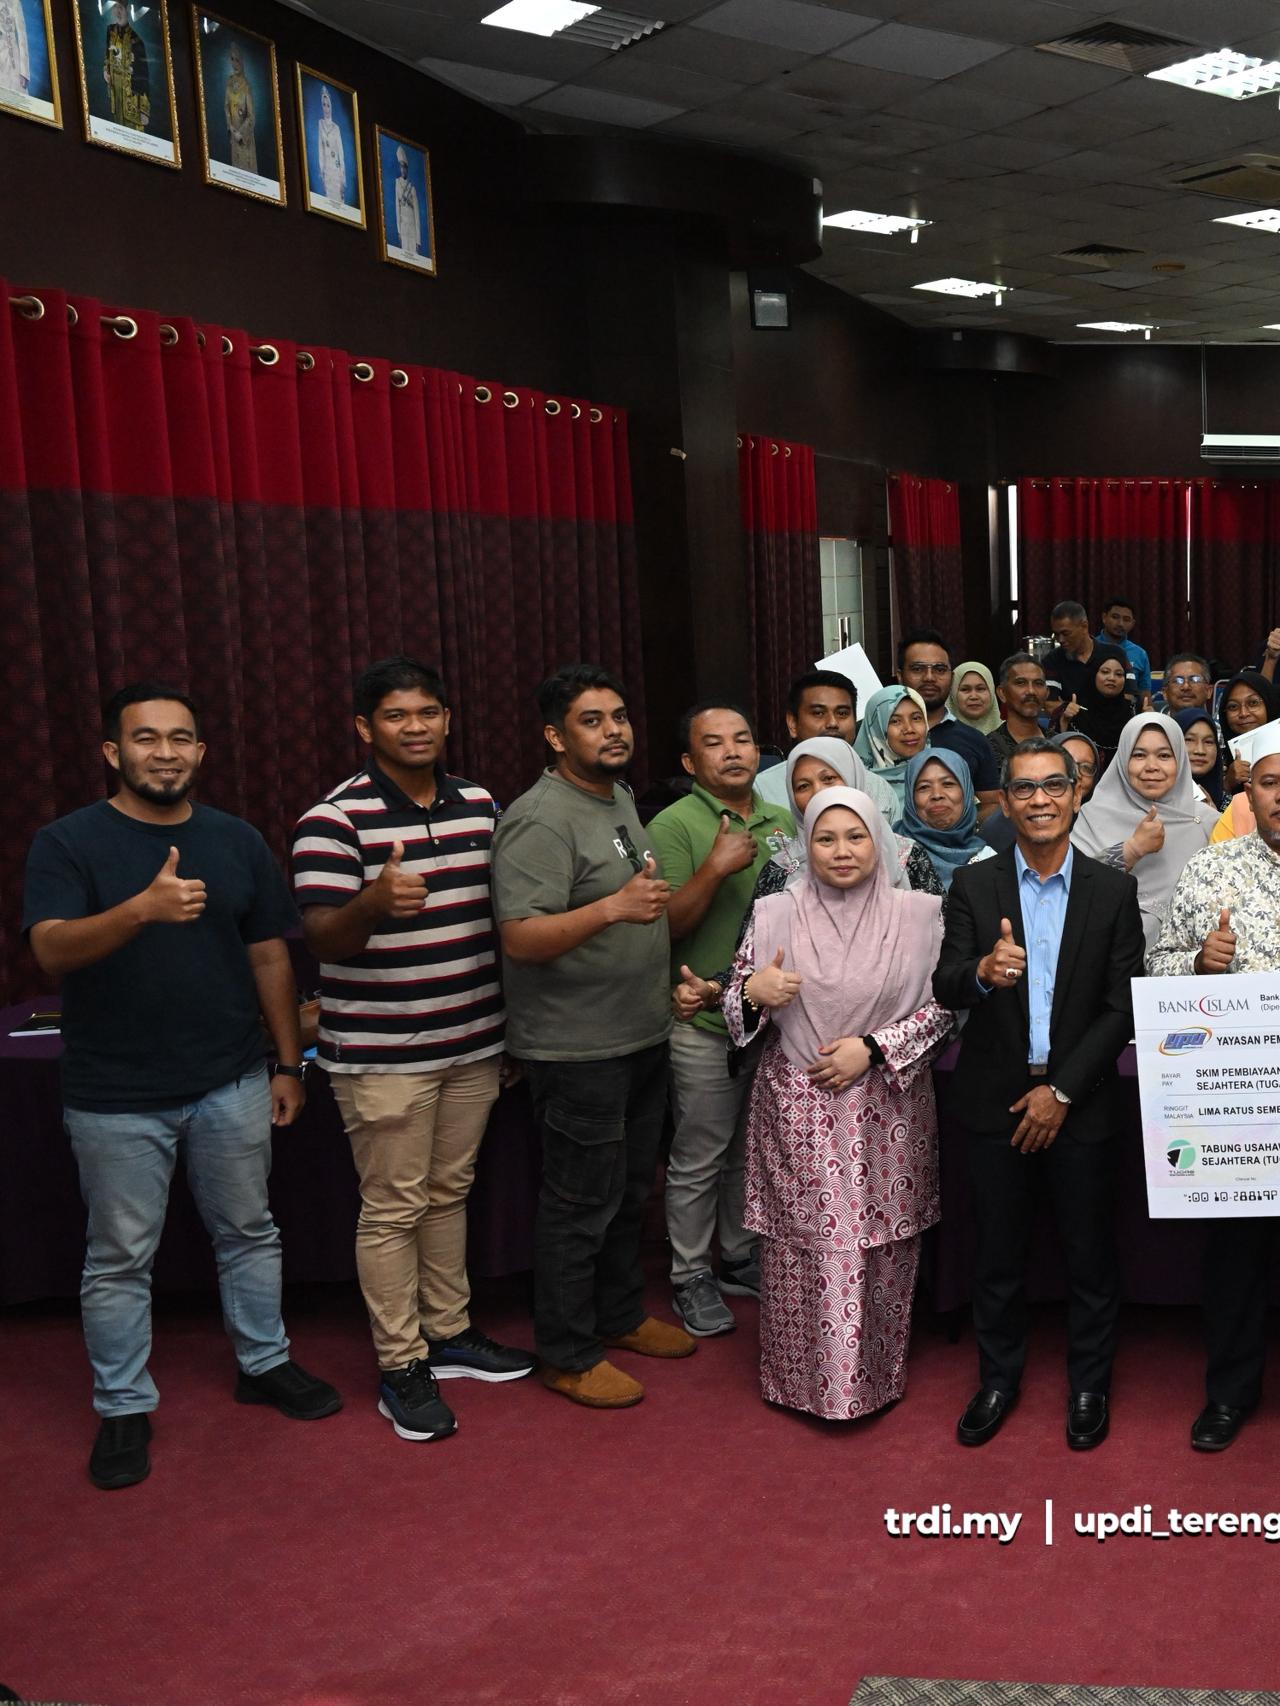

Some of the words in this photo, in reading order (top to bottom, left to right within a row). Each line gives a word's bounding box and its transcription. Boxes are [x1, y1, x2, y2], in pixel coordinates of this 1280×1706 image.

[1259, 993, 1280, 1002] Bank
[1157, 999, 1199, 1015] BANK
[1206, 996, 1250, 1013] ISLAM
[1216, 1035, 1261, 1046] YAYASAN
[1195, 1068, 1220, 1078] SKIM
[1196, 1080, 1254, 1091] SEJAHTERA
[1163, 1112, 1194, 1120] MALAYSIA
[1198, 1107, 1221, 1116] LIMA
[1222, 1105, 1254, 1115] RATUS
[1200, 1143, 1242, 1153] TABUNG
[1201, 1155, 1261, 1166] SEJAHTERA
